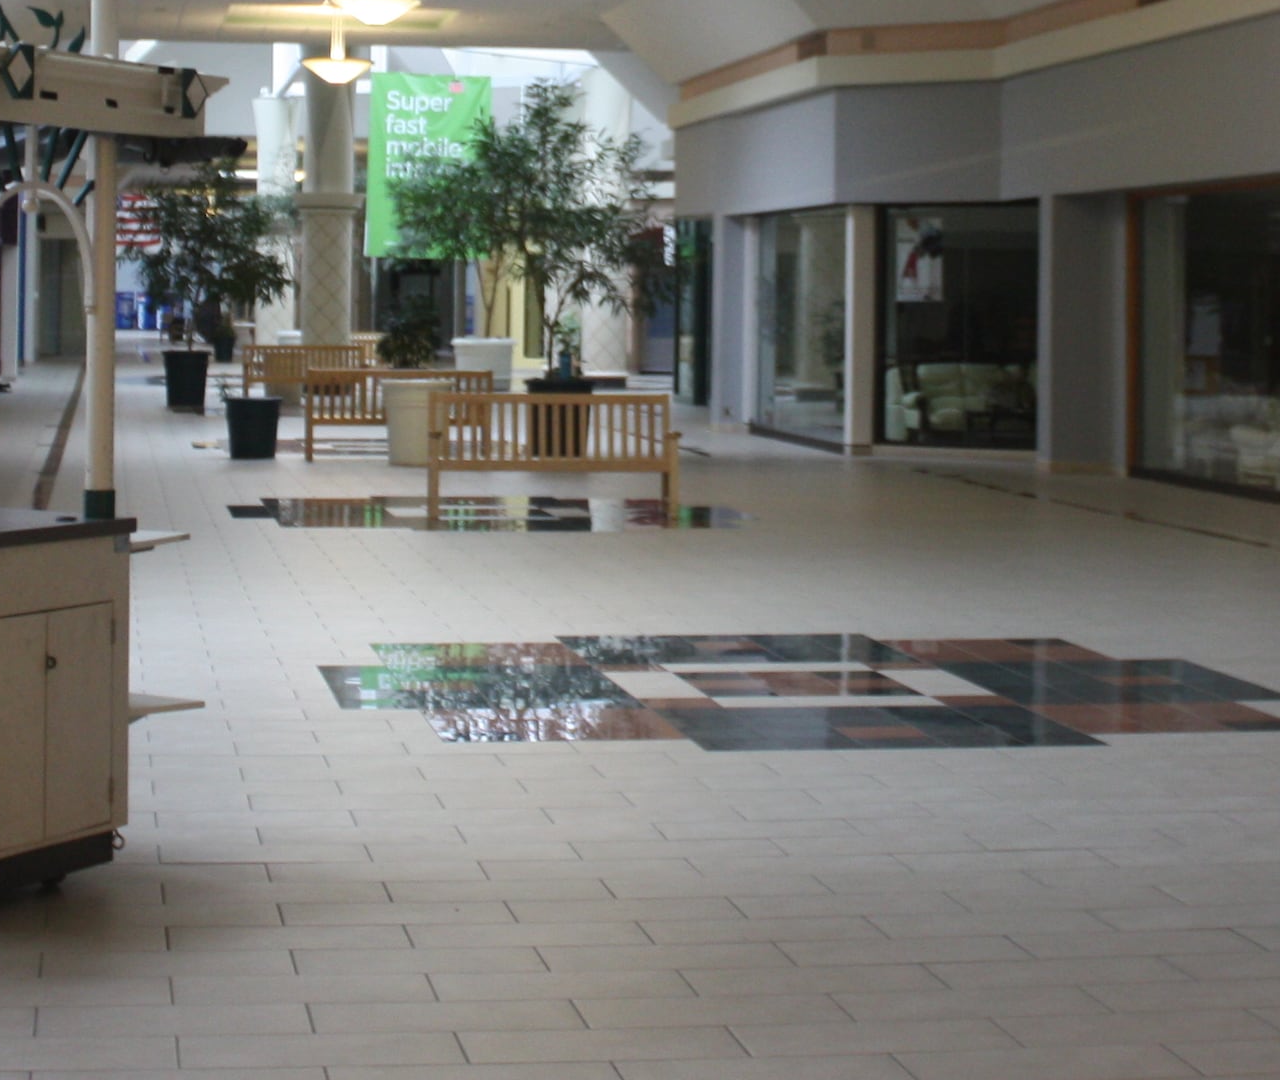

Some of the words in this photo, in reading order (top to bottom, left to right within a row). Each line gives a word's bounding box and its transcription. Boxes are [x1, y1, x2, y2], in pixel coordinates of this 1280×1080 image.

[386, 89, 453, 114] Super
[385, 113, 427, 135] fast
[386, 136, 463, 158] mobile
